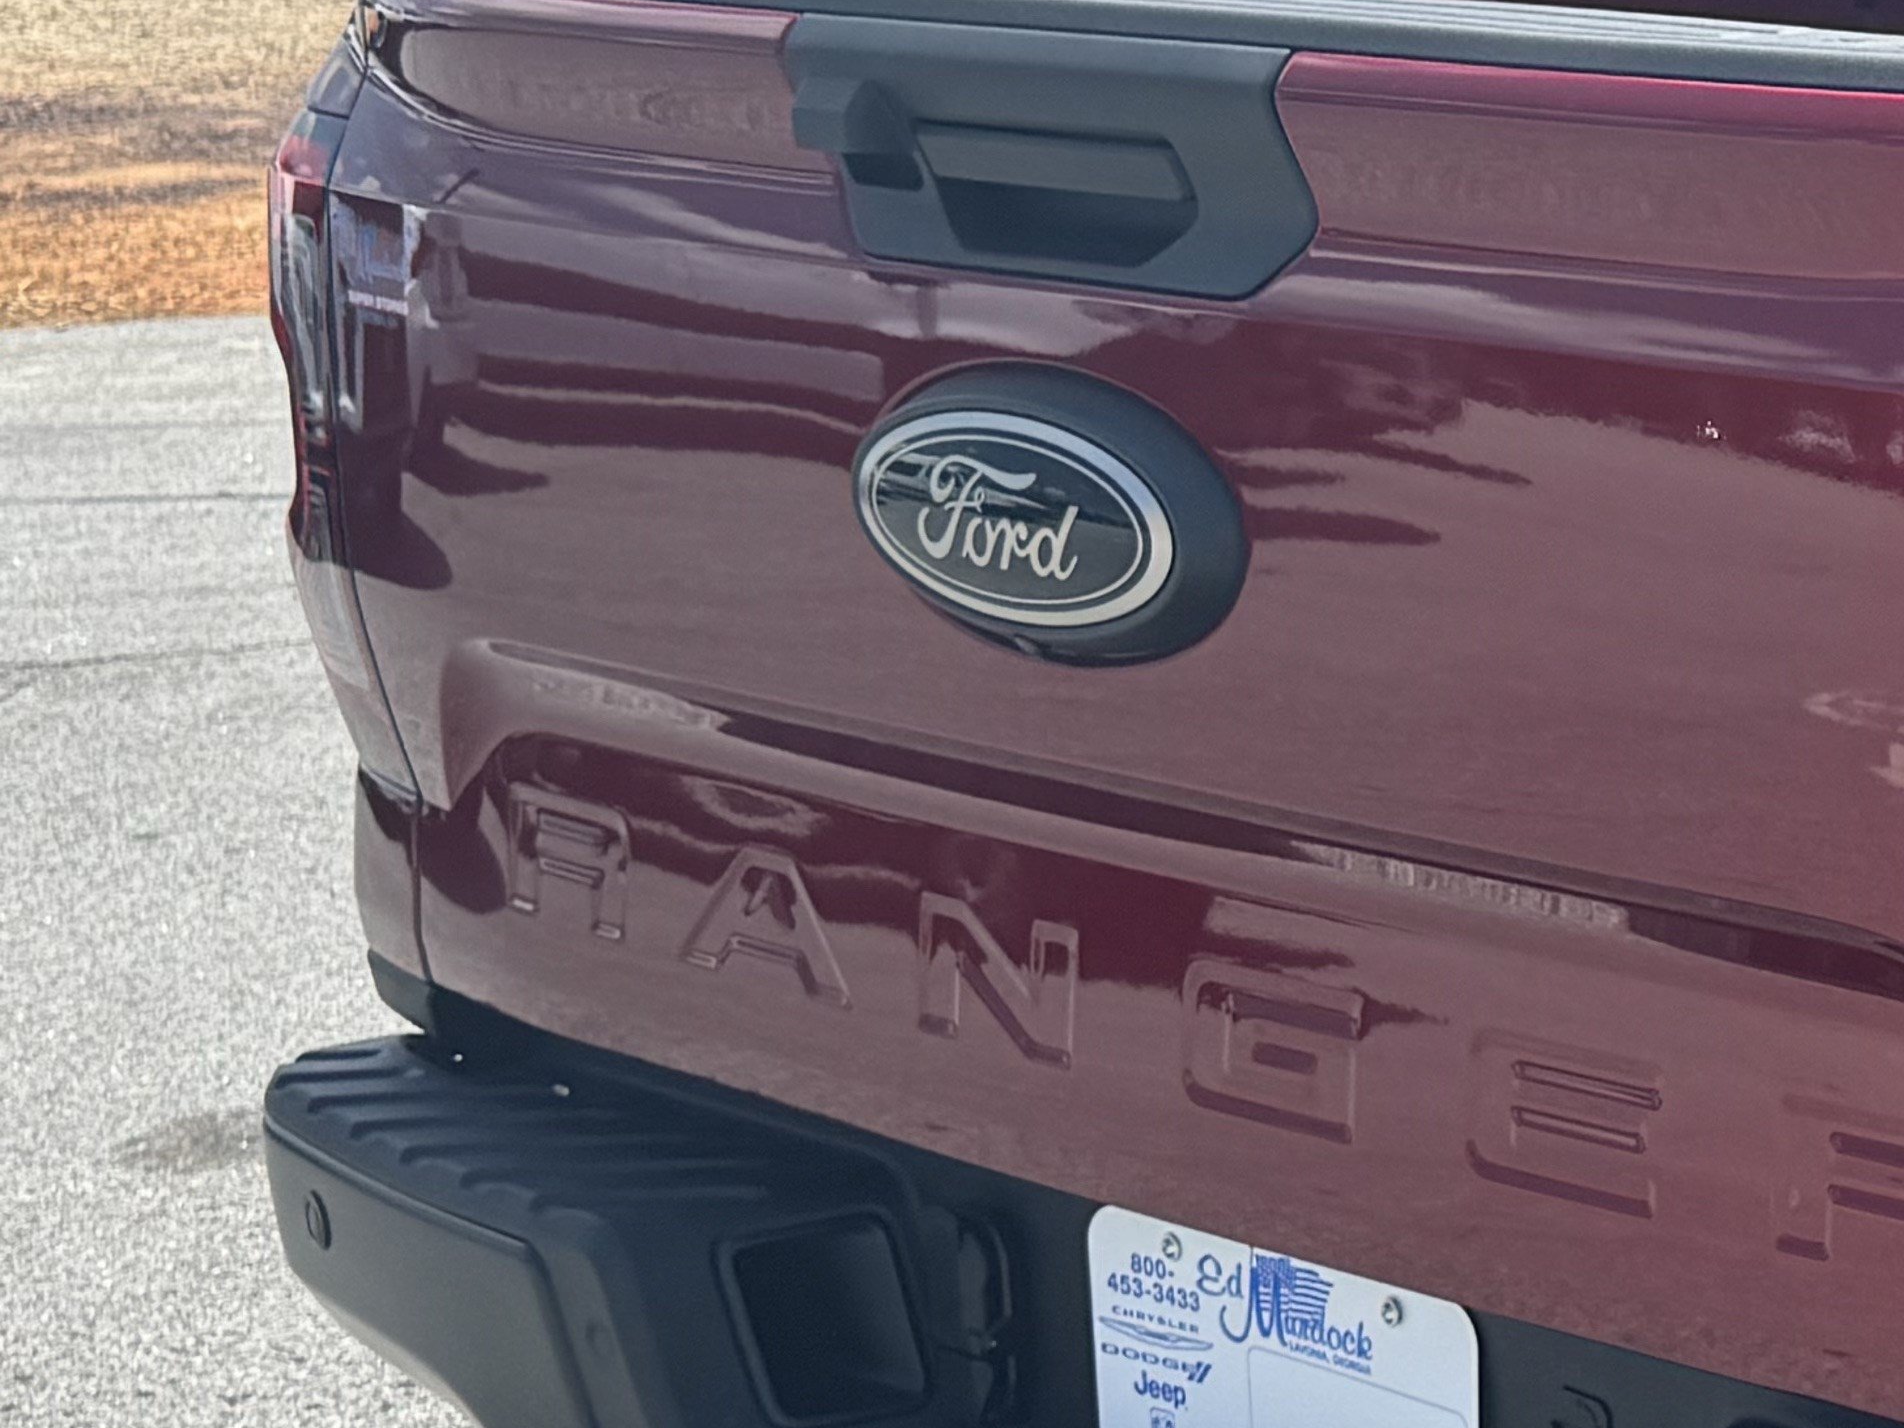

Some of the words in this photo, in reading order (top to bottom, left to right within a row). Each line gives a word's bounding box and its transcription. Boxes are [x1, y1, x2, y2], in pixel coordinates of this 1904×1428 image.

[917, 455, 1079, 581] Ford
[1131, 1252, 1175, 1280] 800-
[1196, 1254, 1243, 1299] Ed
[1107, 1272, 1200, 1312] 453-3433
[1219, 1247, 1373, 1360] Murdock
[1112, 1305, 1199, 1333] CHRYSLER
[1134, 1369, 1187, 1409] Jeep
